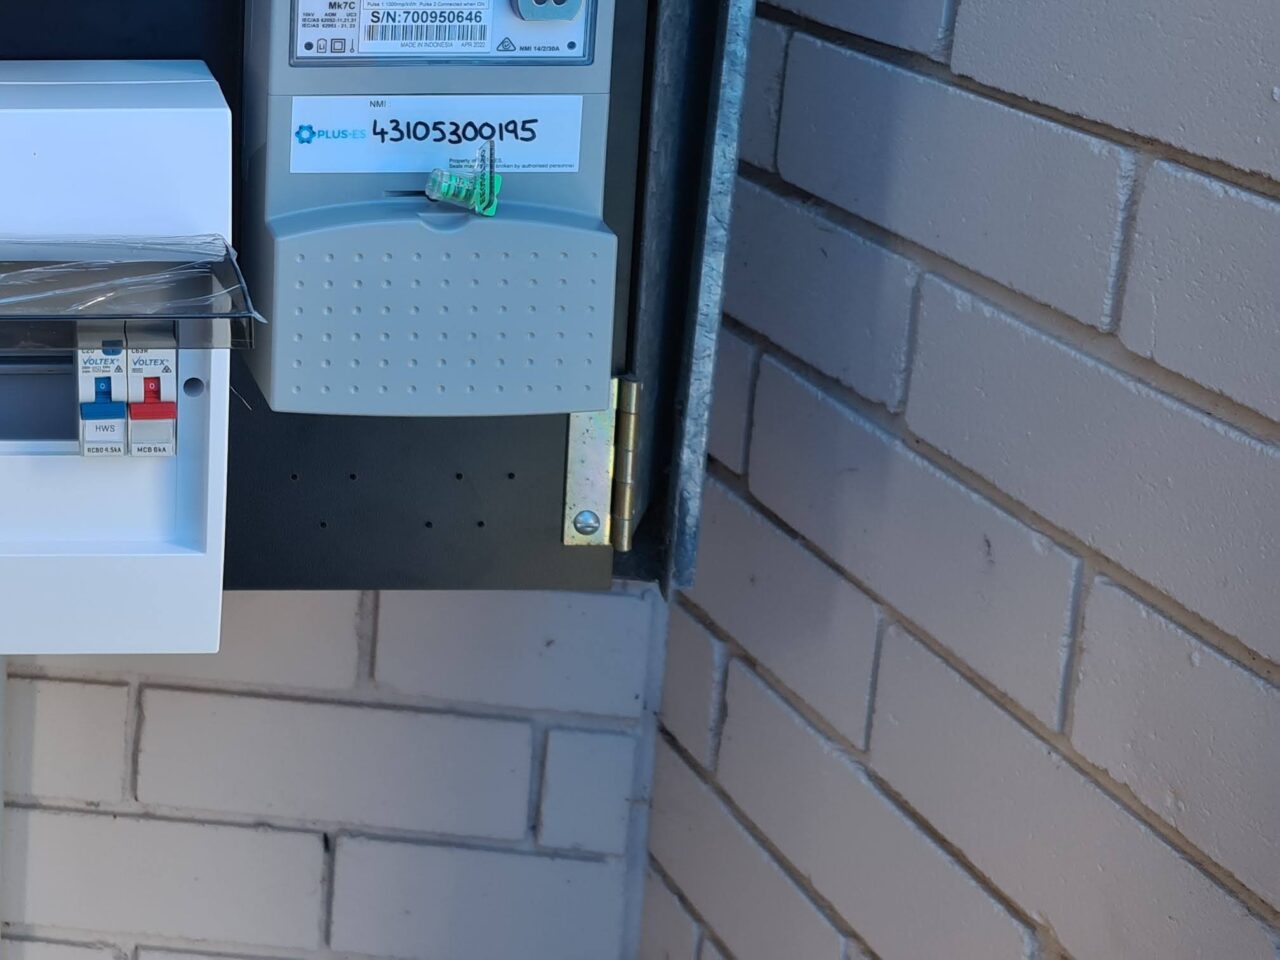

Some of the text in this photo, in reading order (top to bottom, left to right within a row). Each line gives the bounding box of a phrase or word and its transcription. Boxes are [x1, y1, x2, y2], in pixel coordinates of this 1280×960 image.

[328, 2, 356, 10] Mk7C
[370, 11, 482, 23] S/N:700950646
[373, 118, 539, 144] 43105300195
[83, 356, 116, 366] VOLTEX
[133, 356, 166, 367] VOLTEX
[95, 425, 115, 433] HWS
